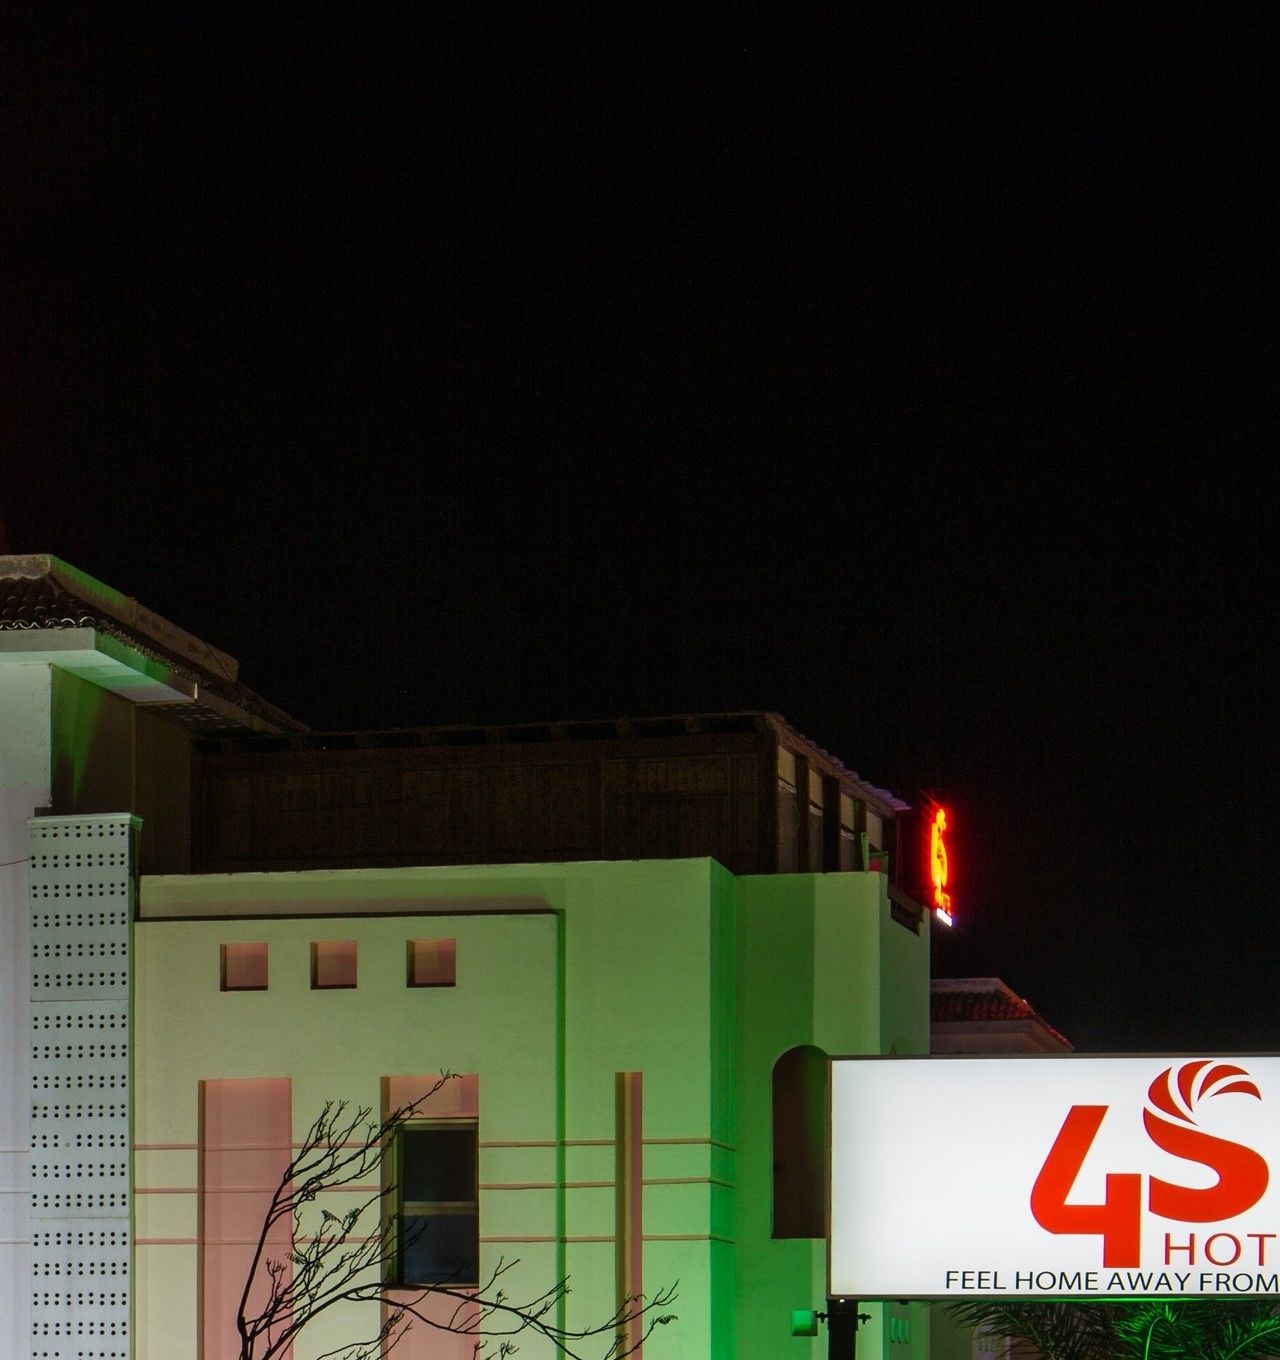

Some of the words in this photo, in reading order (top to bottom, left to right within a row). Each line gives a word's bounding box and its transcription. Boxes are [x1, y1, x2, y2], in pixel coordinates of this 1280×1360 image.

[1029, 1060, 1270, 1269] 4S
[945, 1270, 1007, 1290] FEEL
[1014, 1271, 1099, 1291] HOME
[1106, 1272, 1191, 1291] AWAY
[1199, 1273, 1280, 1293] FROM
